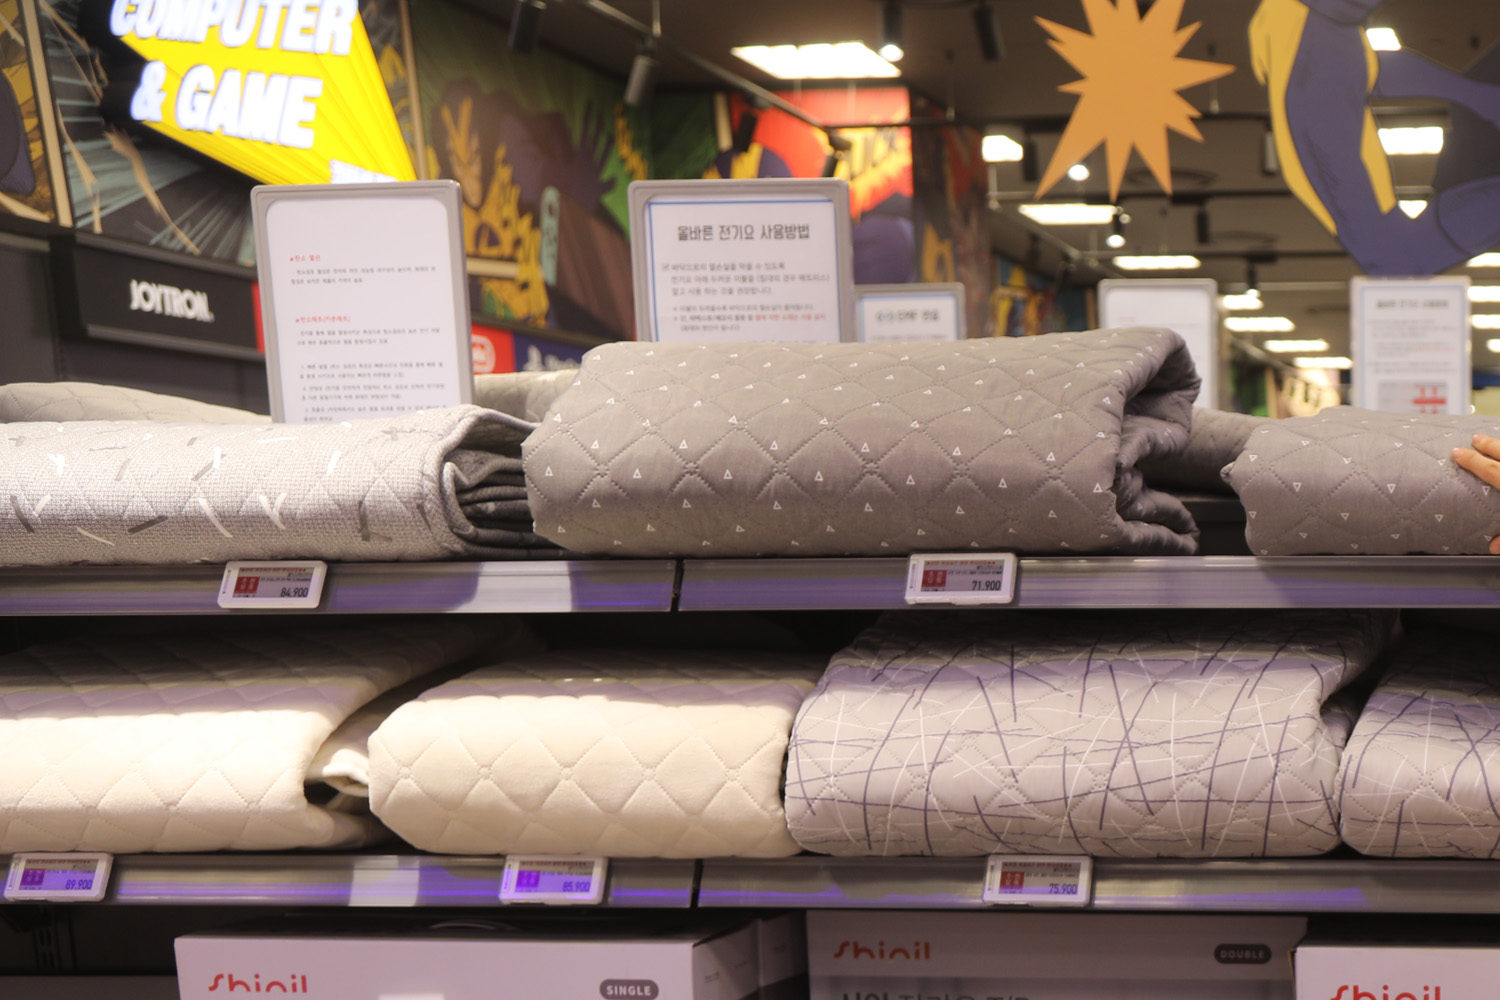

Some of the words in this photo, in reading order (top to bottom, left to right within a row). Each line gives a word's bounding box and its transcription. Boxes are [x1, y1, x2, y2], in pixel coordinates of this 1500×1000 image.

[130, 61, 167, 122] &
[175, 65, 323, 149] GAME
[678, 225, 713, 241] 올바른
[719, 224, 754, 240] 전기요
[760, 223, 810, 240] 사용방법
[971, 580, 1001, 591] 71.900
[280, 587, 309, 598] 84.900
[1220, 949, 1265, 959] DOUBLE
[606, 984, 652, 997] SINGLE
